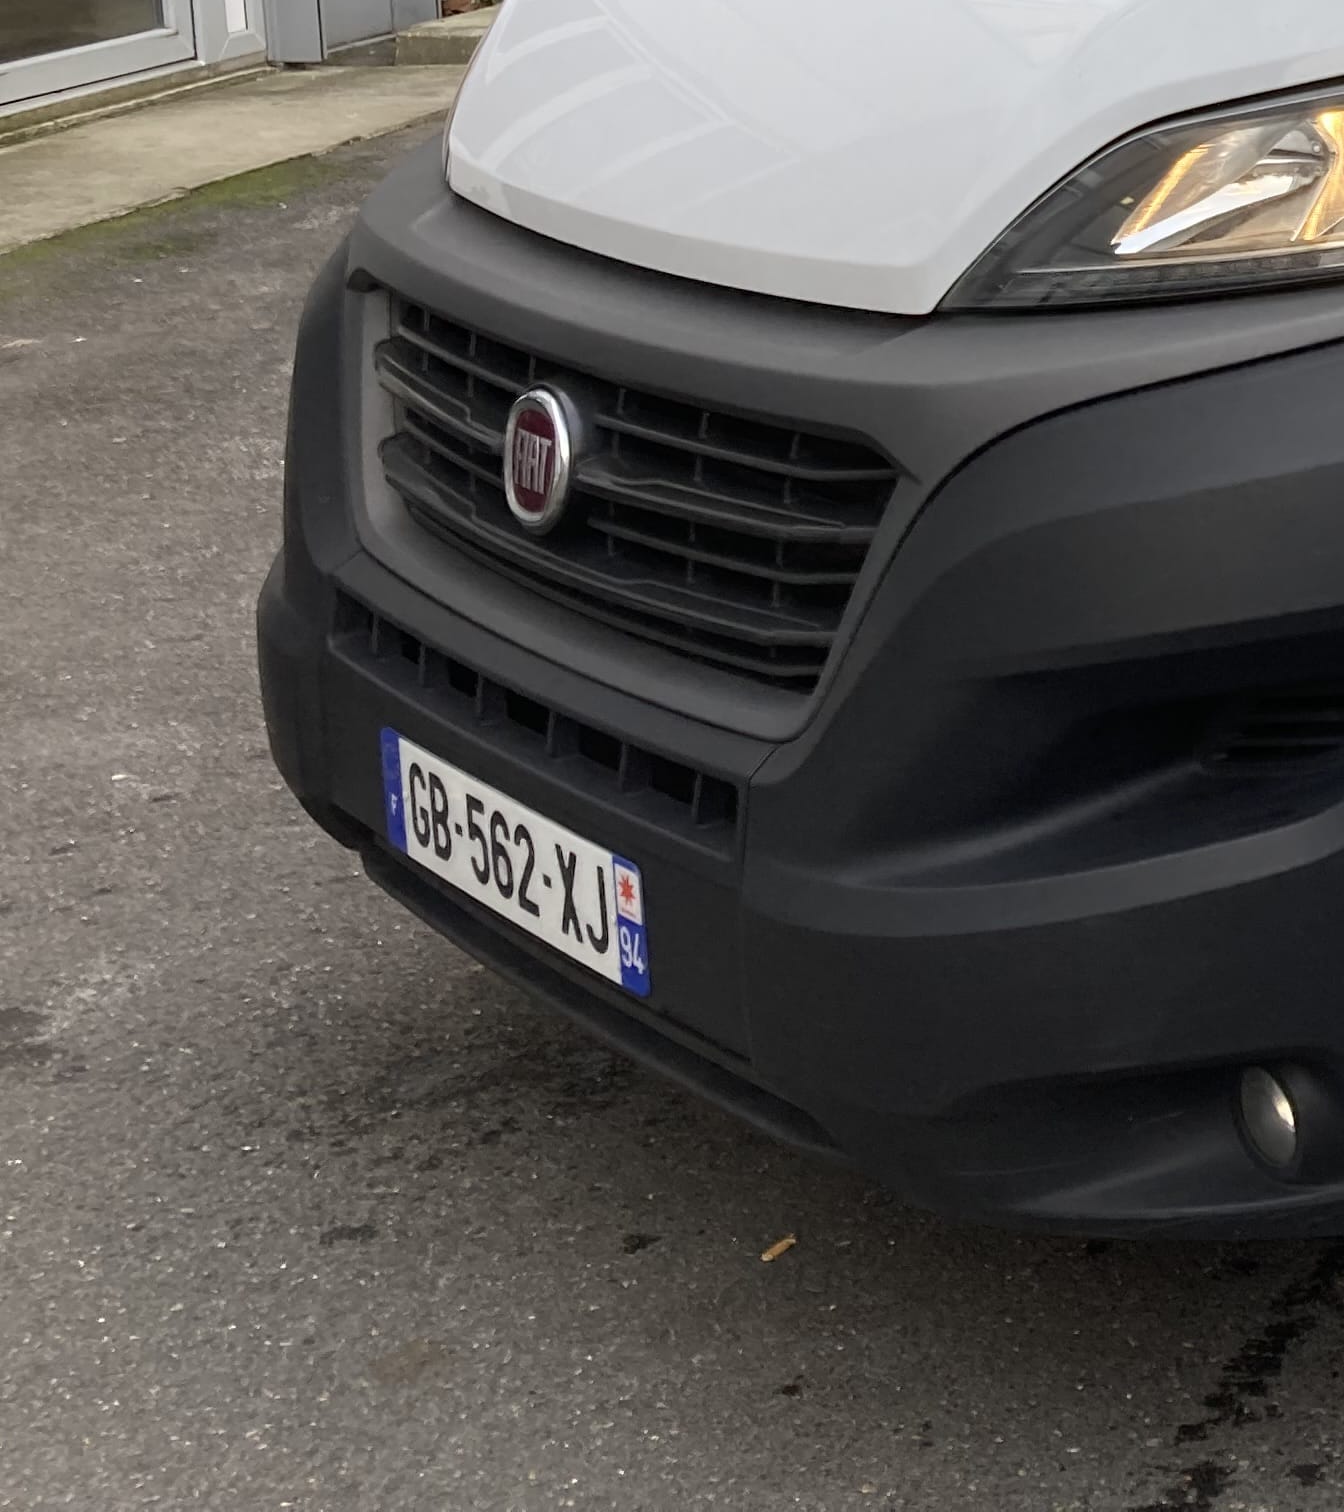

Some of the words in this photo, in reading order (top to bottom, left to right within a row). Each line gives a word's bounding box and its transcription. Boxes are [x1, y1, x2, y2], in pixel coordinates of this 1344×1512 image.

[514, 427, 552, 494] FIAT
[408, 762, 610, 955] GB-562-XJ
[619, 925, 646, 975] 94
